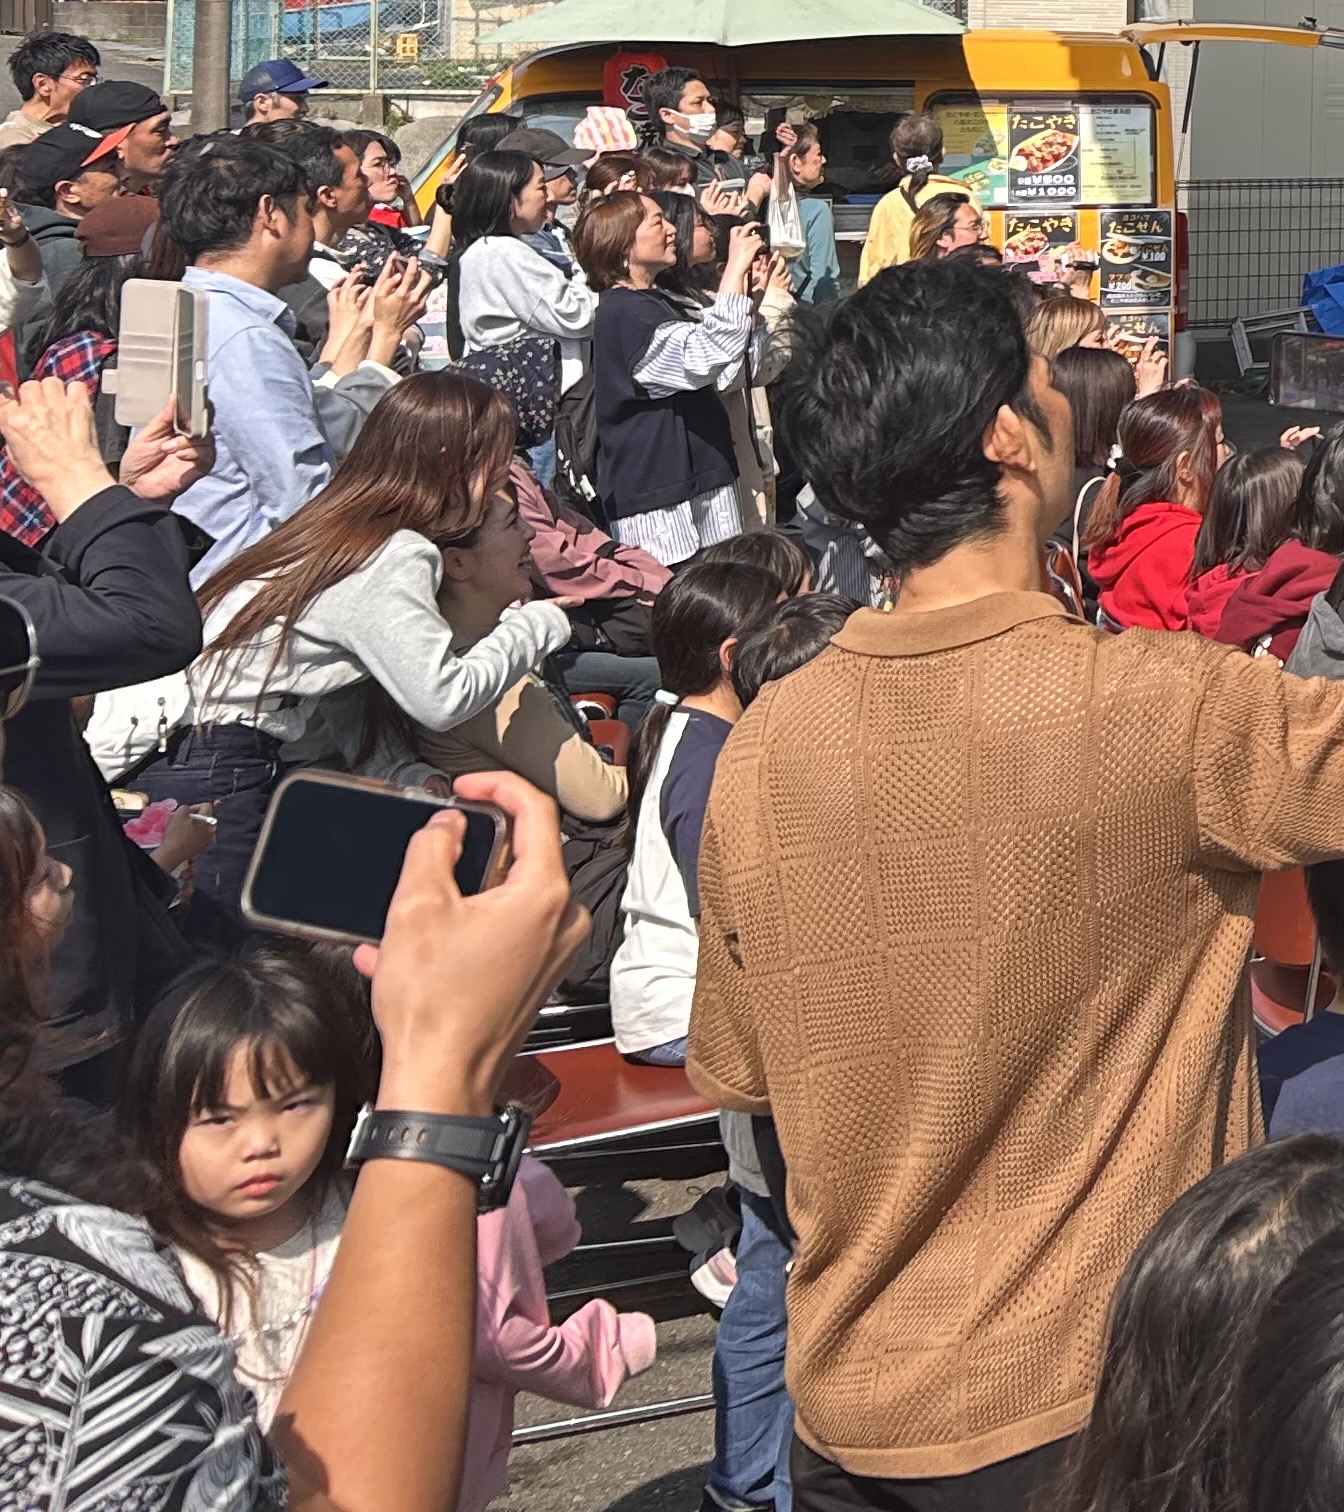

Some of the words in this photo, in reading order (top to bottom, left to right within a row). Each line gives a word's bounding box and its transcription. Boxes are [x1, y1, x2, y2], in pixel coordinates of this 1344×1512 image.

[1011, 113, 1077, 130] たこやき
[1008, 217, 1073, 233] たこやき
[1108, 220, 1164, 234] たこせん
[1120, 321, 1162, 334] こせん
